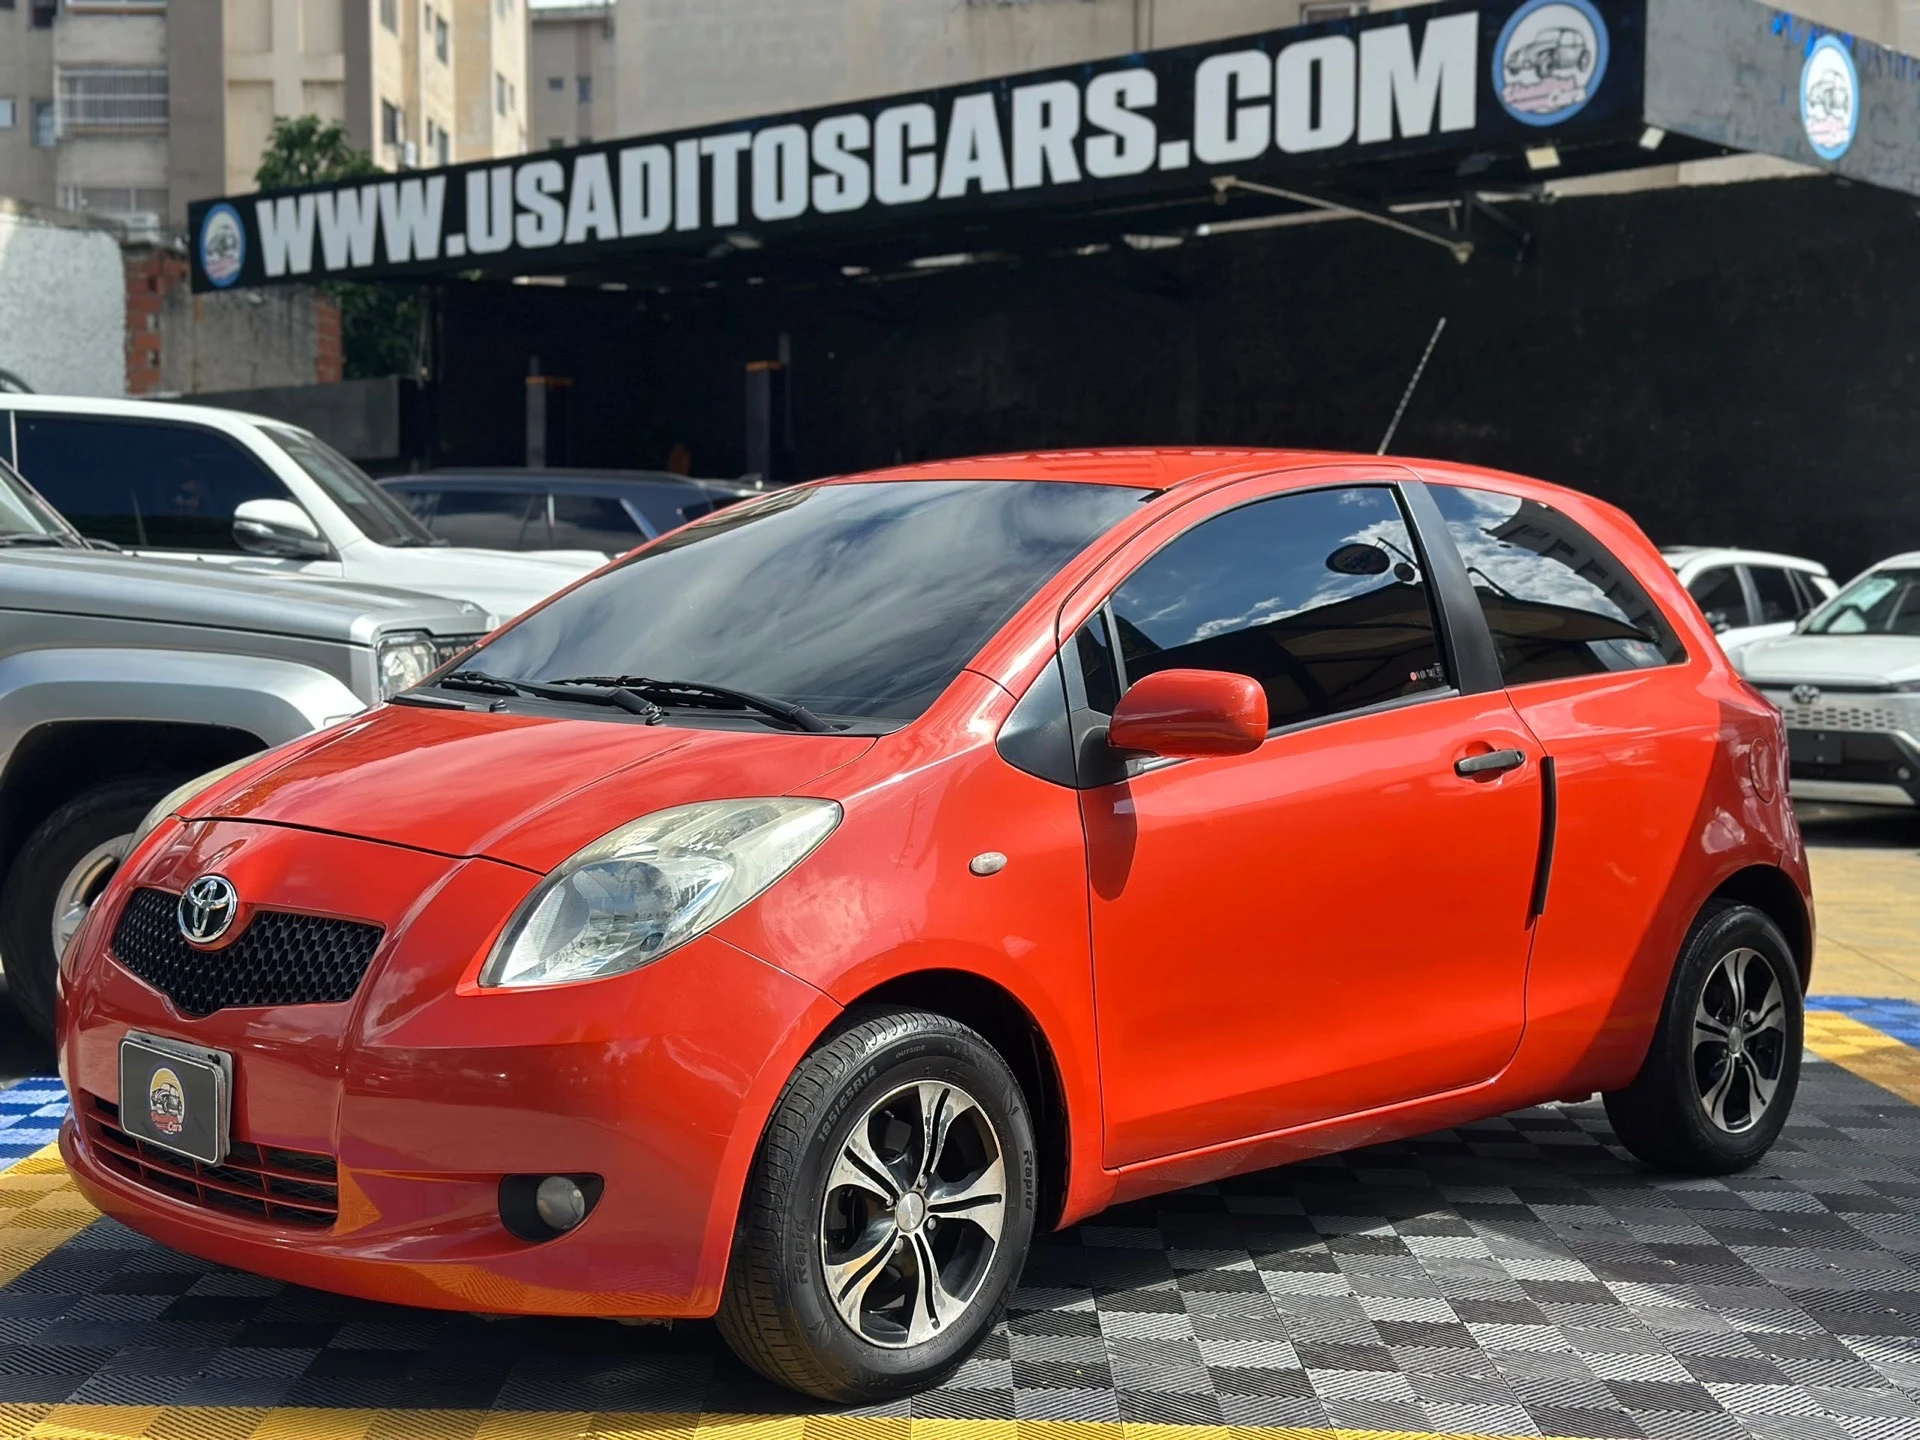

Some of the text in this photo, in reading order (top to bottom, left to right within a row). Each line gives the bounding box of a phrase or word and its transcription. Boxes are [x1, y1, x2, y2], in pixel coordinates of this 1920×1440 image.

[256, 11, 1478, 277] WWW.USADITOSCARS.COM
[895, 1044, 926, 1059] OUTSIDE
[817, 1065, 877, 1142] 185/65R14
[1022, 1149, 1034, 1211] Rapid
